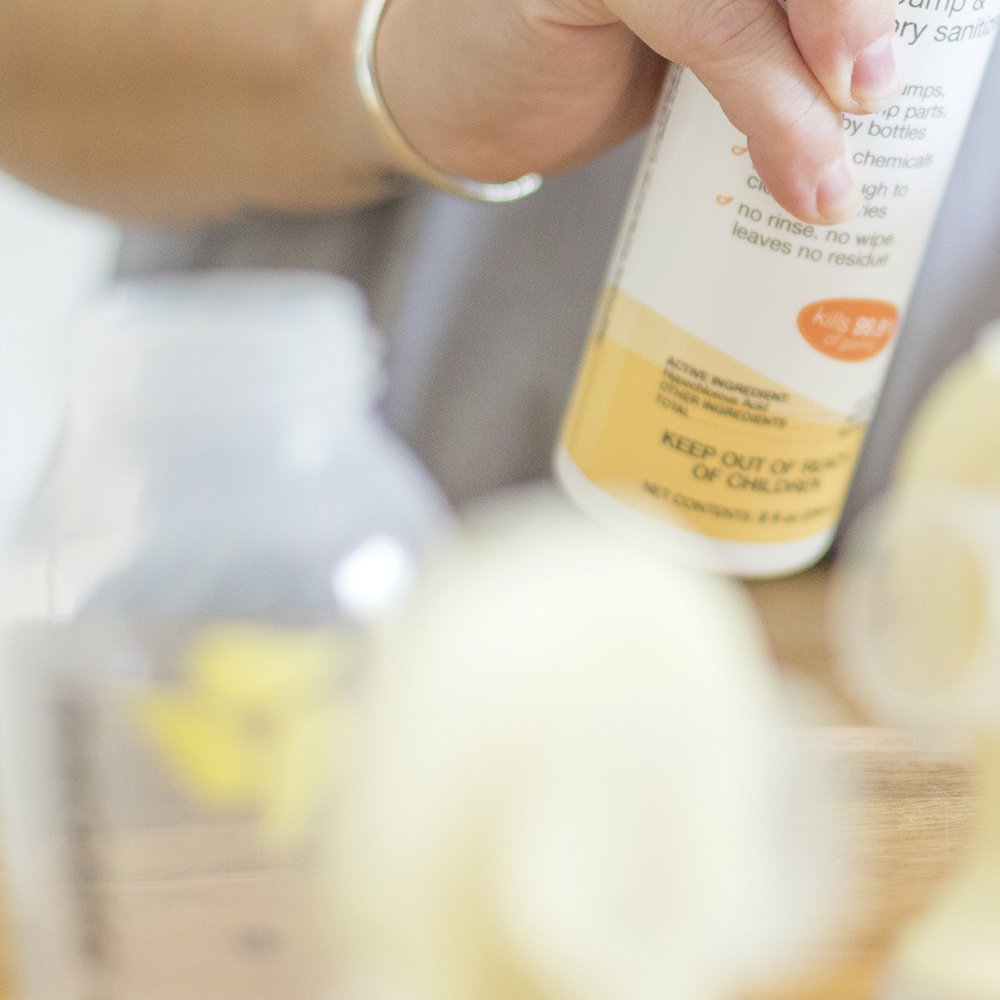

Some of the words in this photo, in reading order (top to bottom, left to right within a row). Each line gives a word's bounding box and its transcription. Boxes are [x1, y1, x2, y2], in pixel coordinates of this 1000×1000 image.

[868, 117, 927, 140] bottles
[852, 150, 935, 169] chemicals
[893, 183, 909, 198] to
[737, 203, 762, 222] no
[826, 229, 850, 245] no
[732, 220, 793, 255] leaves
[797, 245, 823, 262] no
[827, 251, 889, 267] residue
[661, 429, 717, 459] KEEP
[722, 451, 765, 472] OUT
[770, 459, 796, 475] OF
[692, 464, 720, 482] OF
